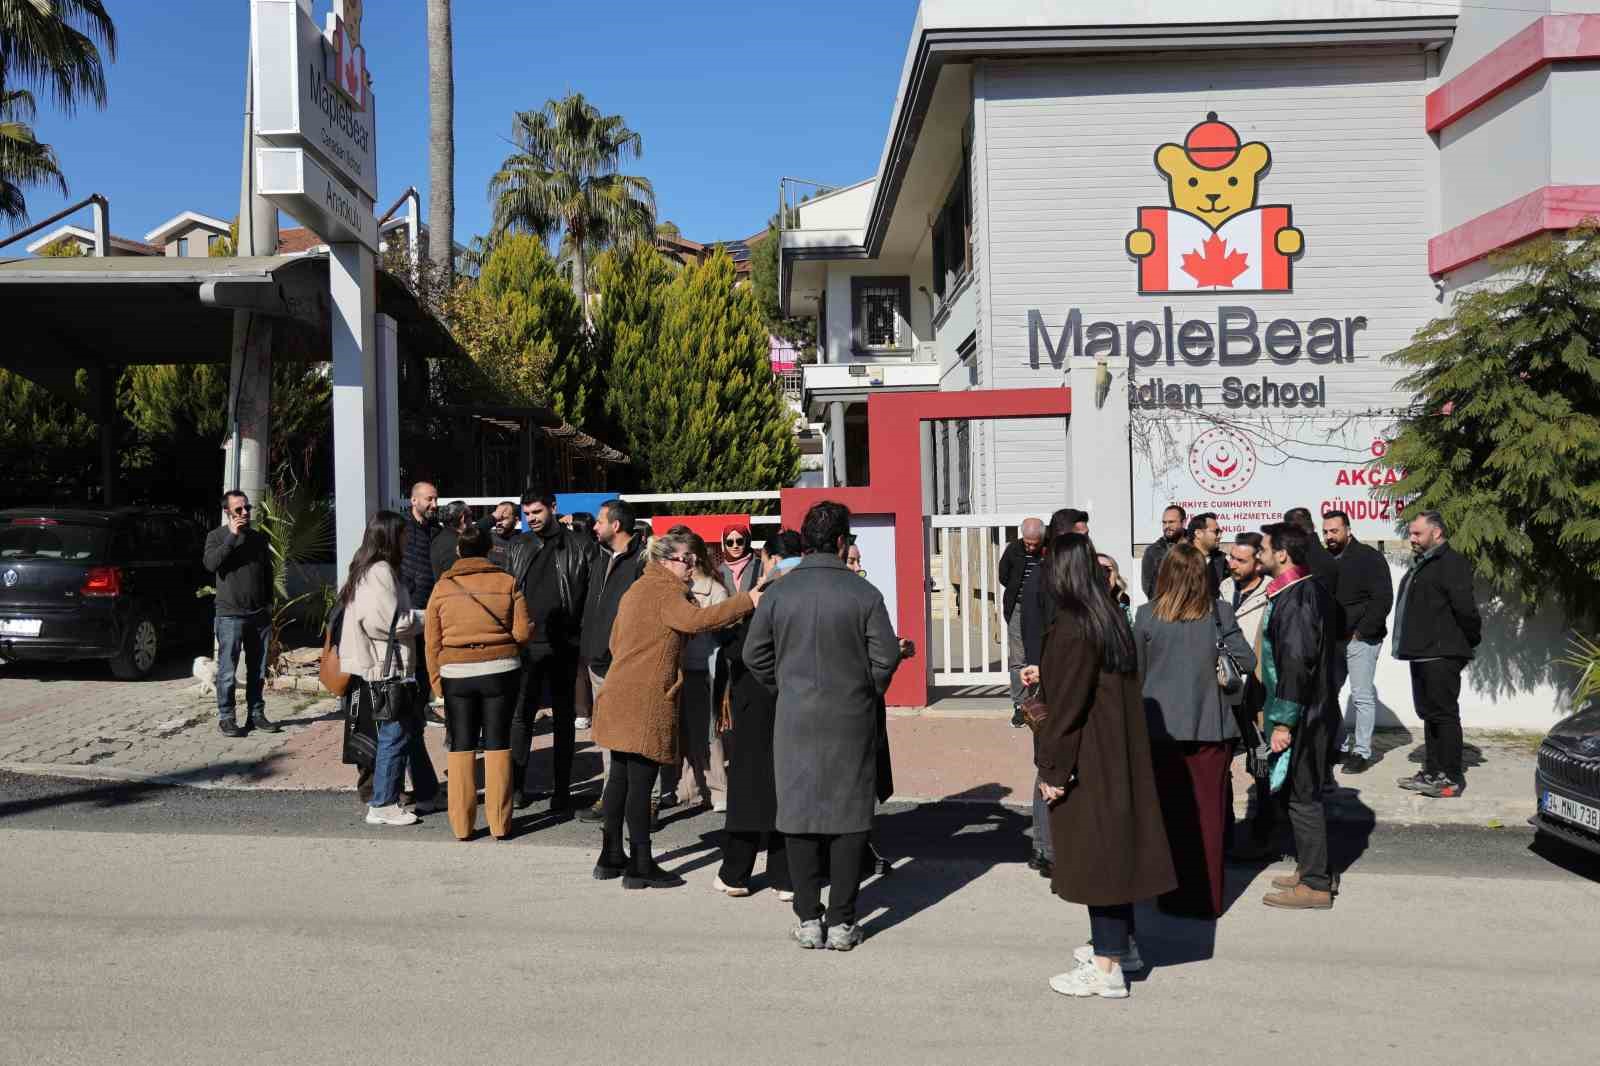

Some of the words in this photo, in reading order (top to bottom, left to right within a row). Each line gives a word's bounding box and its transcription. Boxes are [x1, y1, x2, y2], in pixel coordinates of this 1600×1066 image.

[309, 63, 369, 153] MapleBear
[1027, 305, 1369, 370] MapleBear
[1134, 377, 1203, 409] dian
[1221, 376, 1326, 409] School
[1580, 805, 1597, 826] 738
